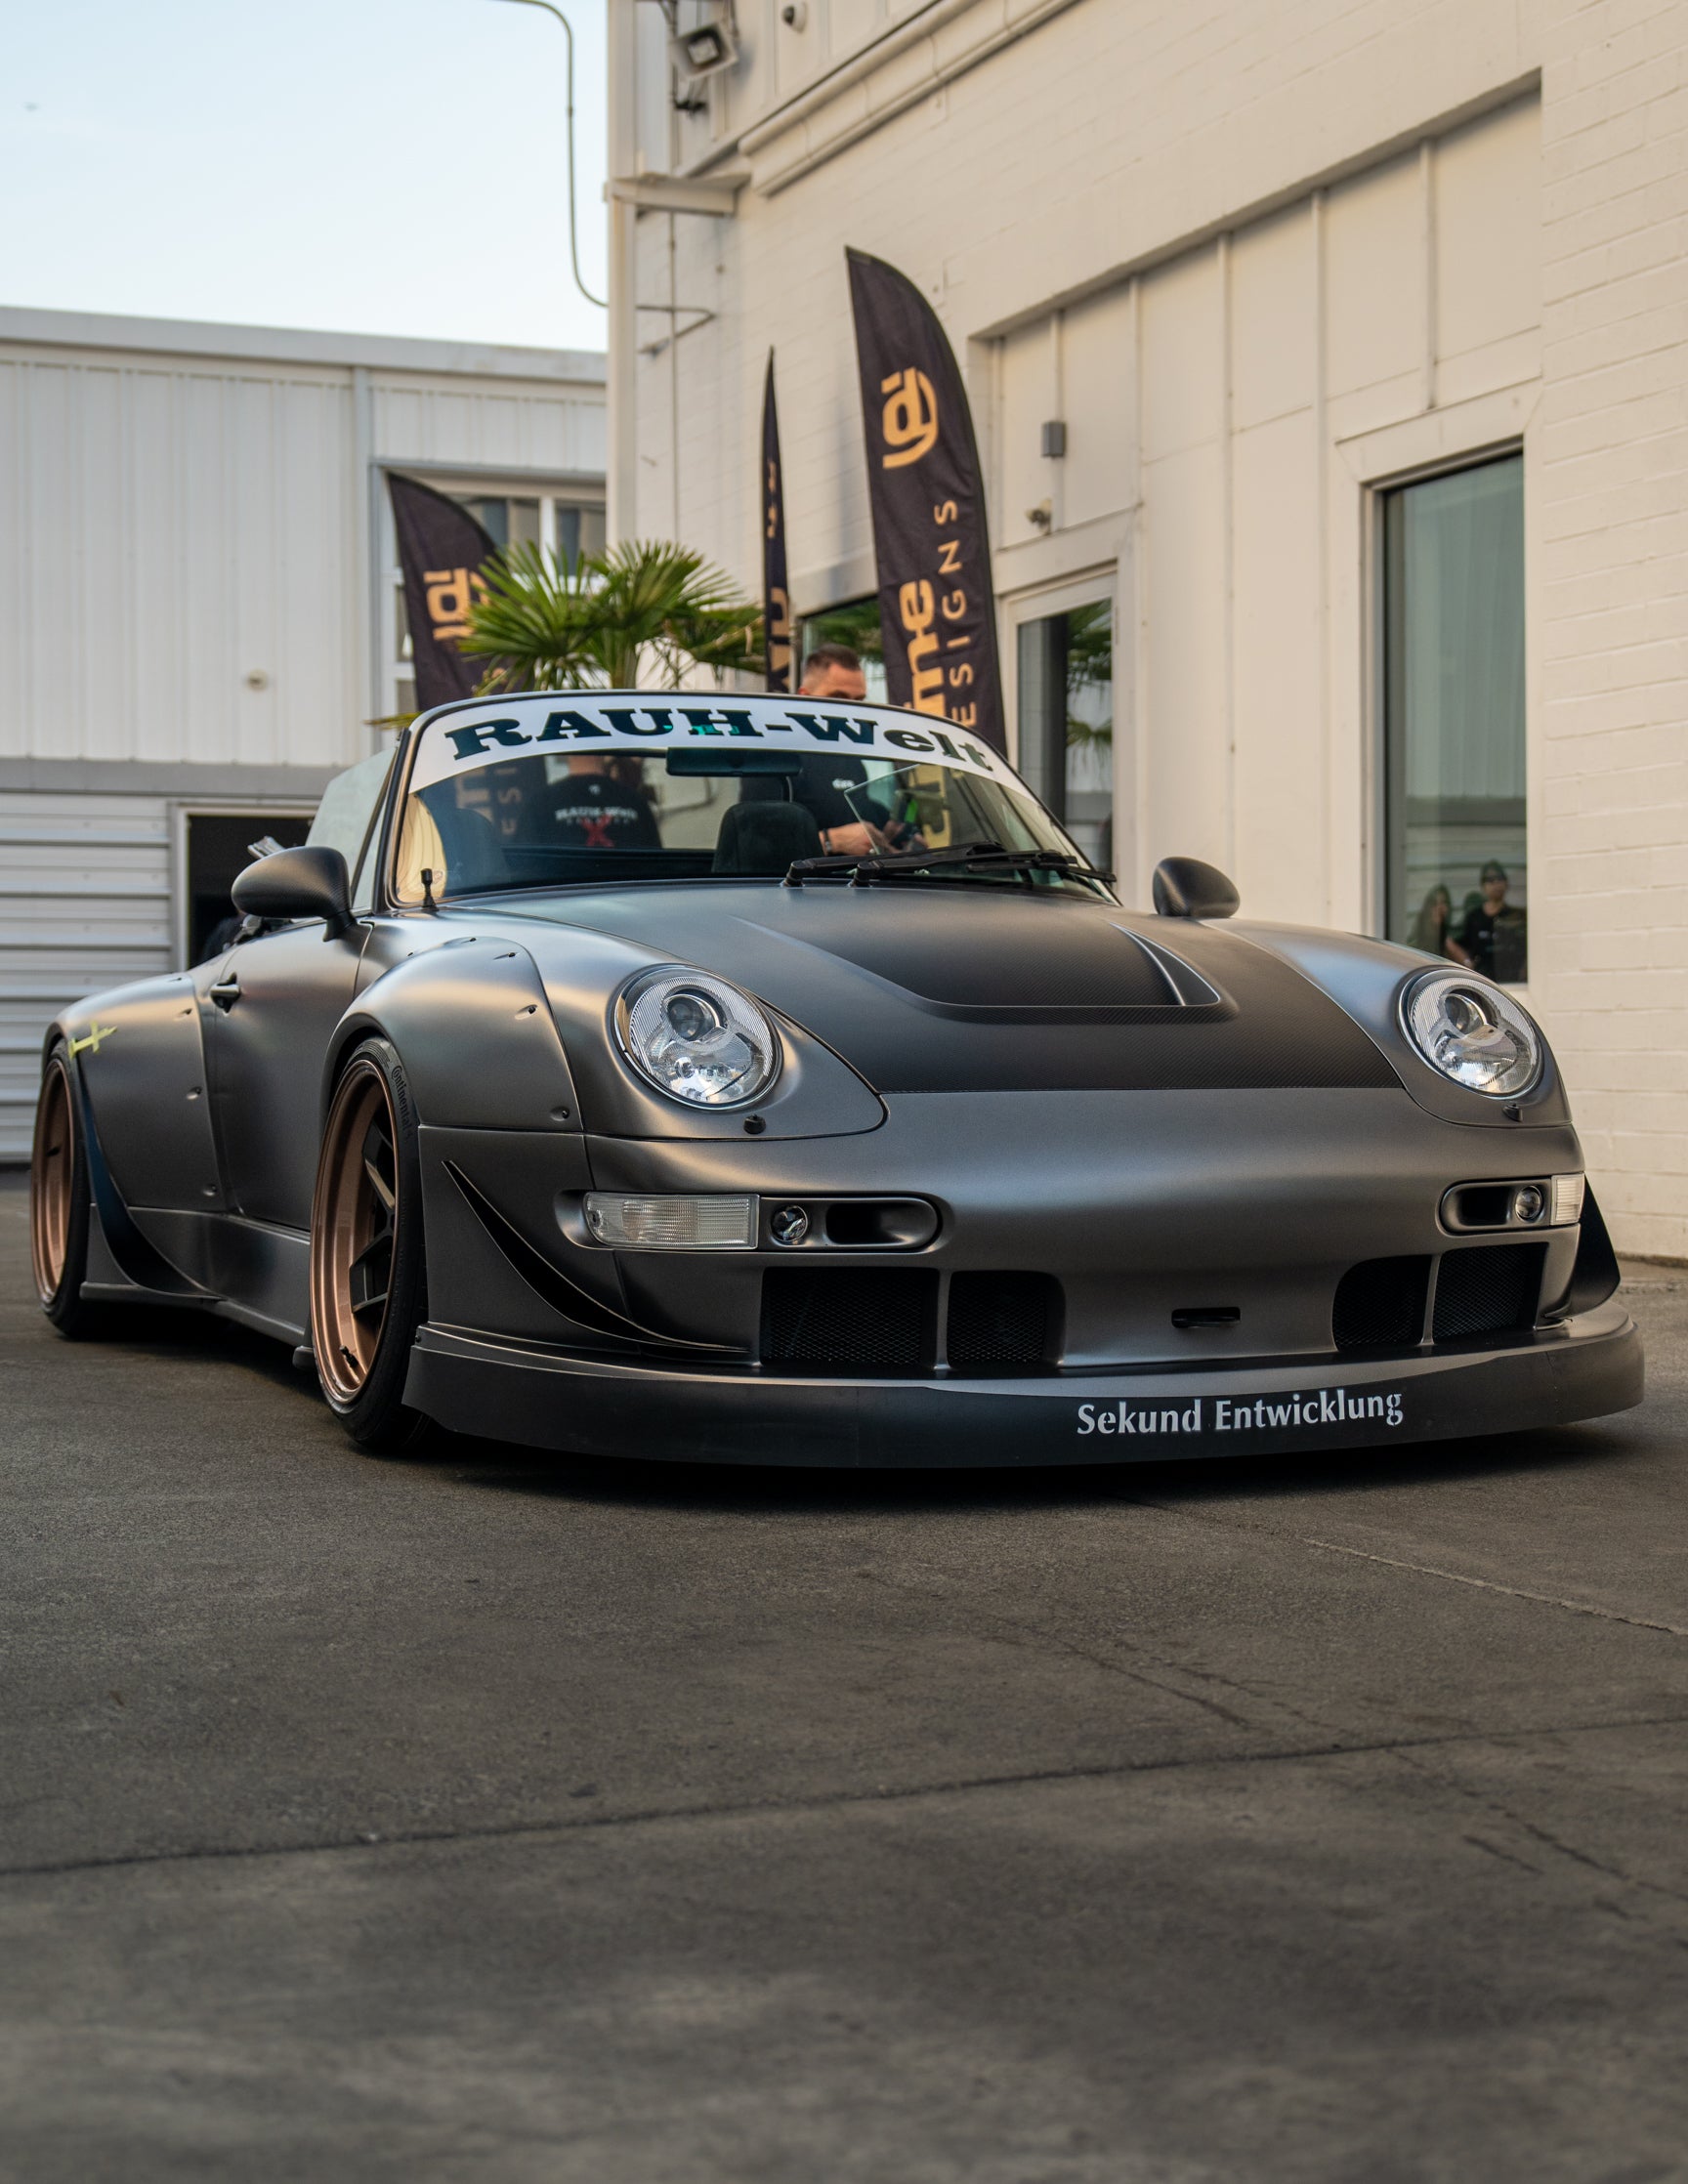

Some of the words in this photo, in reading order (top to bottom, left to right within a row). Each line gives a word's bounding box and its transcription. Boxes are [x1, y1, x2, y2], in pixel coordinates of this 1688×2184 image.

[934, 499, 977, 727] ESIGNS
[444, 708, 993, 772] RAUH-Welt
[1077, 1399, 1201, 1435] Sekund
[1215, 1389, 1403, 1430] Entwicklung
